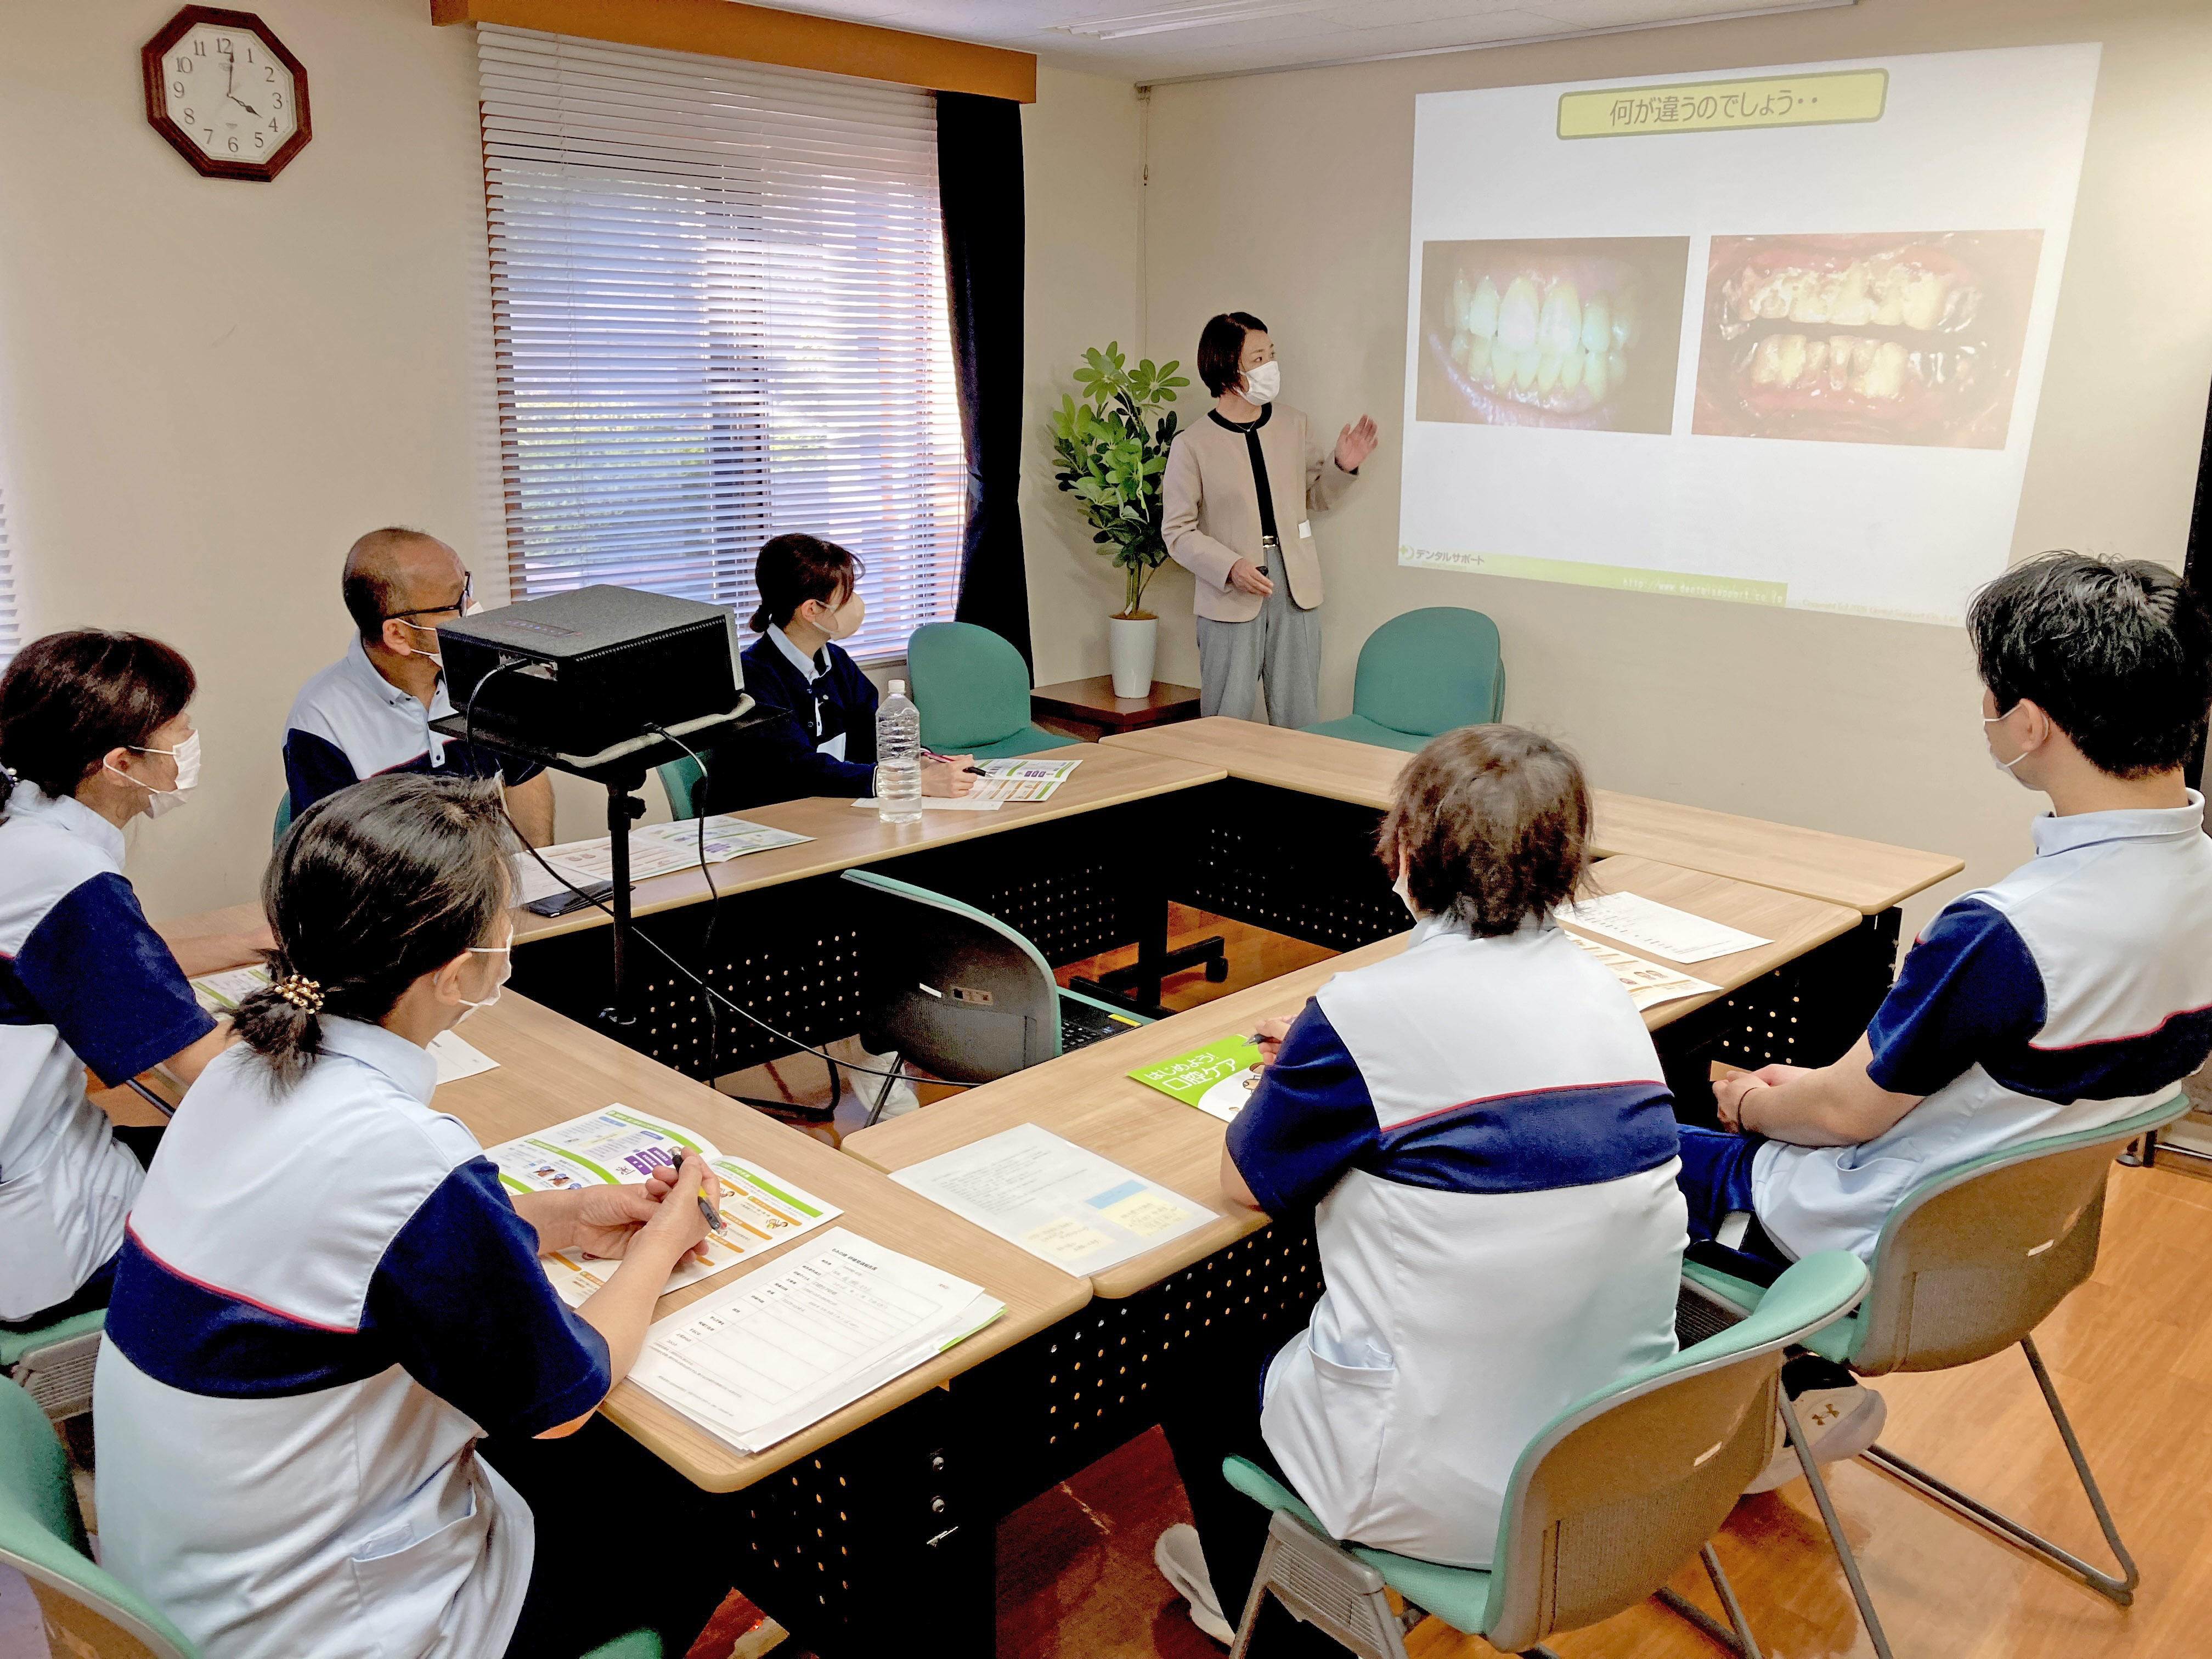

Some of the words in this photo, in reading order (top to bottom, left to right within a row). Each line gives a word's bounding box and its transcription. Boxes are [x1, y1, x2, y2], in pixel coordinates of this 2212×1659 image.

[194, 40, 206, 57] 11
[216, 38, 232, 54] 12
[246, 48, 253, 64] 1
[176, 57, 193, 74] 10
[264, 66, 275, 82] 2
[173, 81, 185, 98] 9
[272, 92, 283, 109] 3
[183, 108, 195, 125] 8
[268, 117, 278, 132] 4
[204, 128, 213, 145] 7
[228, 137, 239, 153] 6
[255, 132, 263, 148] 5
[1416, 549, 1485, 566] デンタルサポート
[1161, 1058, 1235, 1091] 口腔ケア
